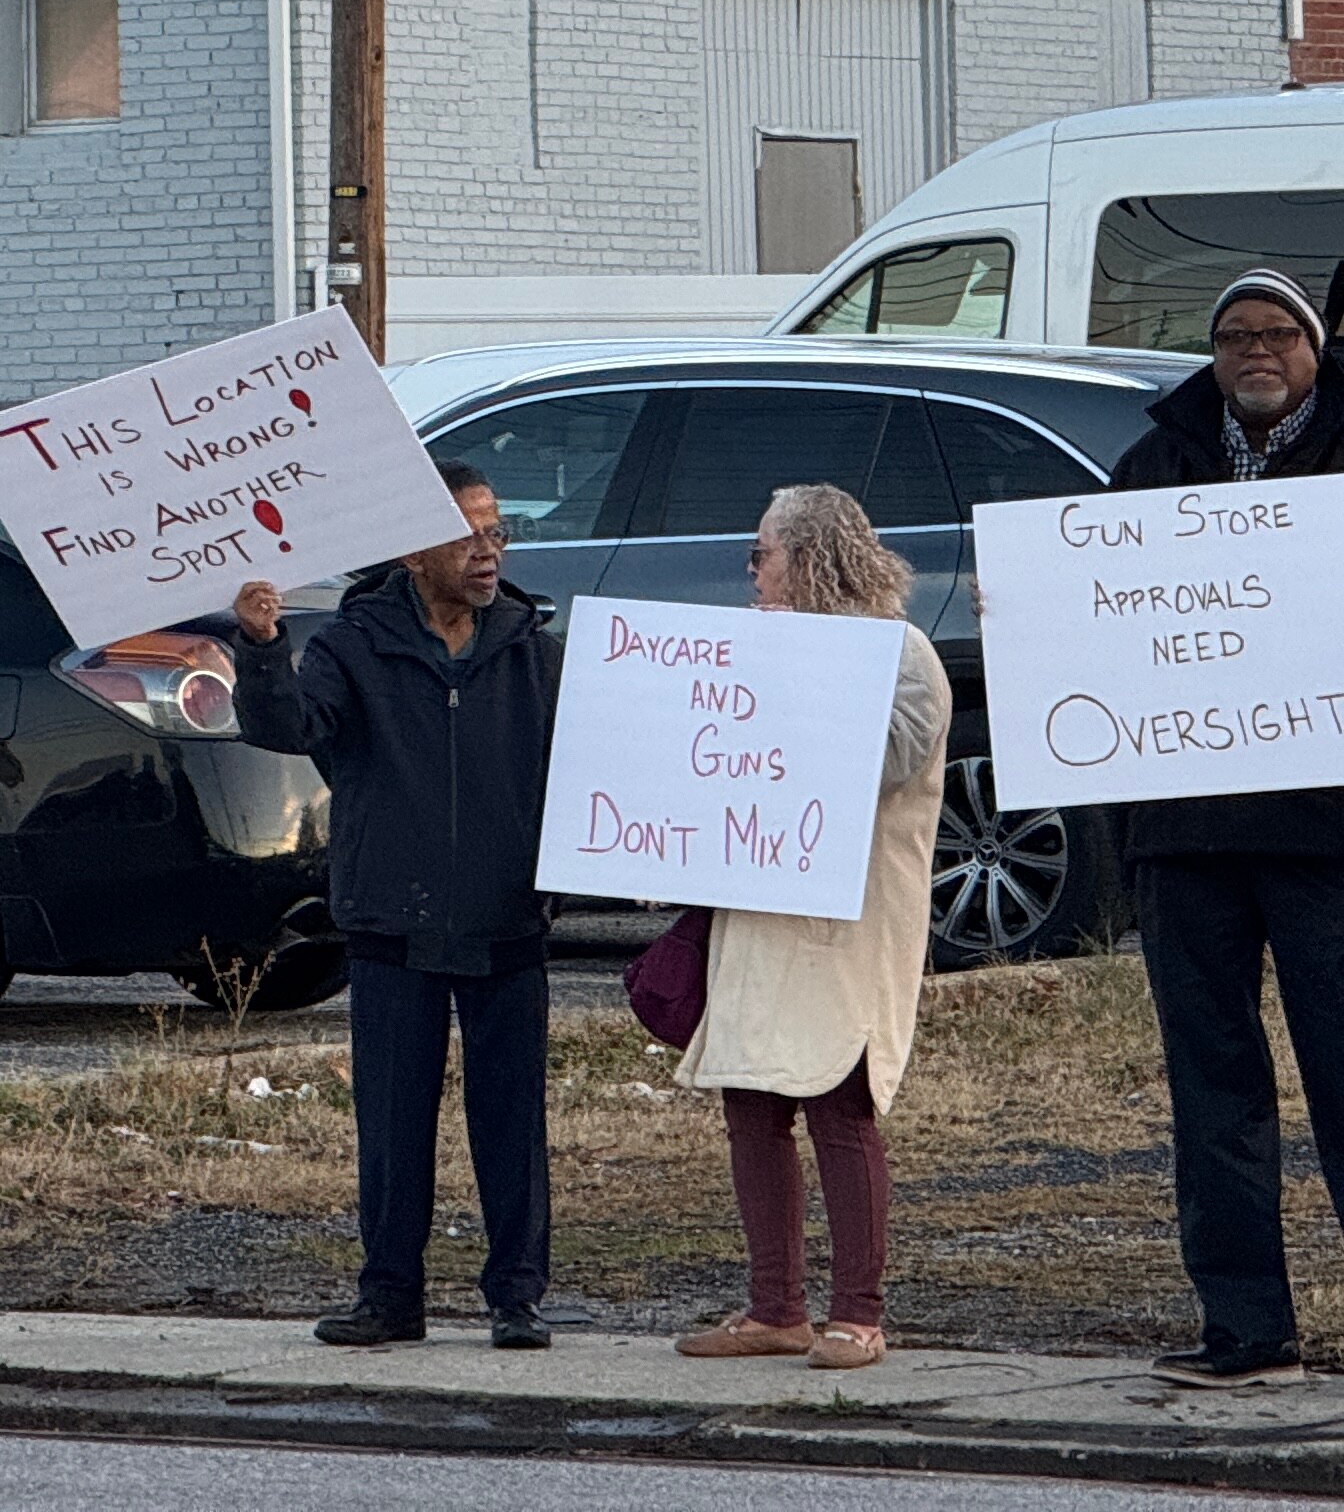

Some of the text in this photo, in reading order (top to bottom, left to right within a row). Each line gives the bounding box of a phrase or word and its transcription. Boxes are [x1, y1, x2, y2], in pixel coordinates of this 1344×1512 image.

[98, 469, 134, 497] IS
[155, 461, 327, 537] ANOTHER
[1060, 493, 1293, 548] GUN STORE
[1093, 574, 1272, 618] APPROVALS
[603, 615, 732, 668] DAYCARE
[1153, 631, 1245, 666] NEED
[690, 679, 756, 721] AND
[691, 723, 786, 781] GUNS
[1046, 692, 1344, 767] OVERSIGHT
[576, 791, 699, 867] DON'T
